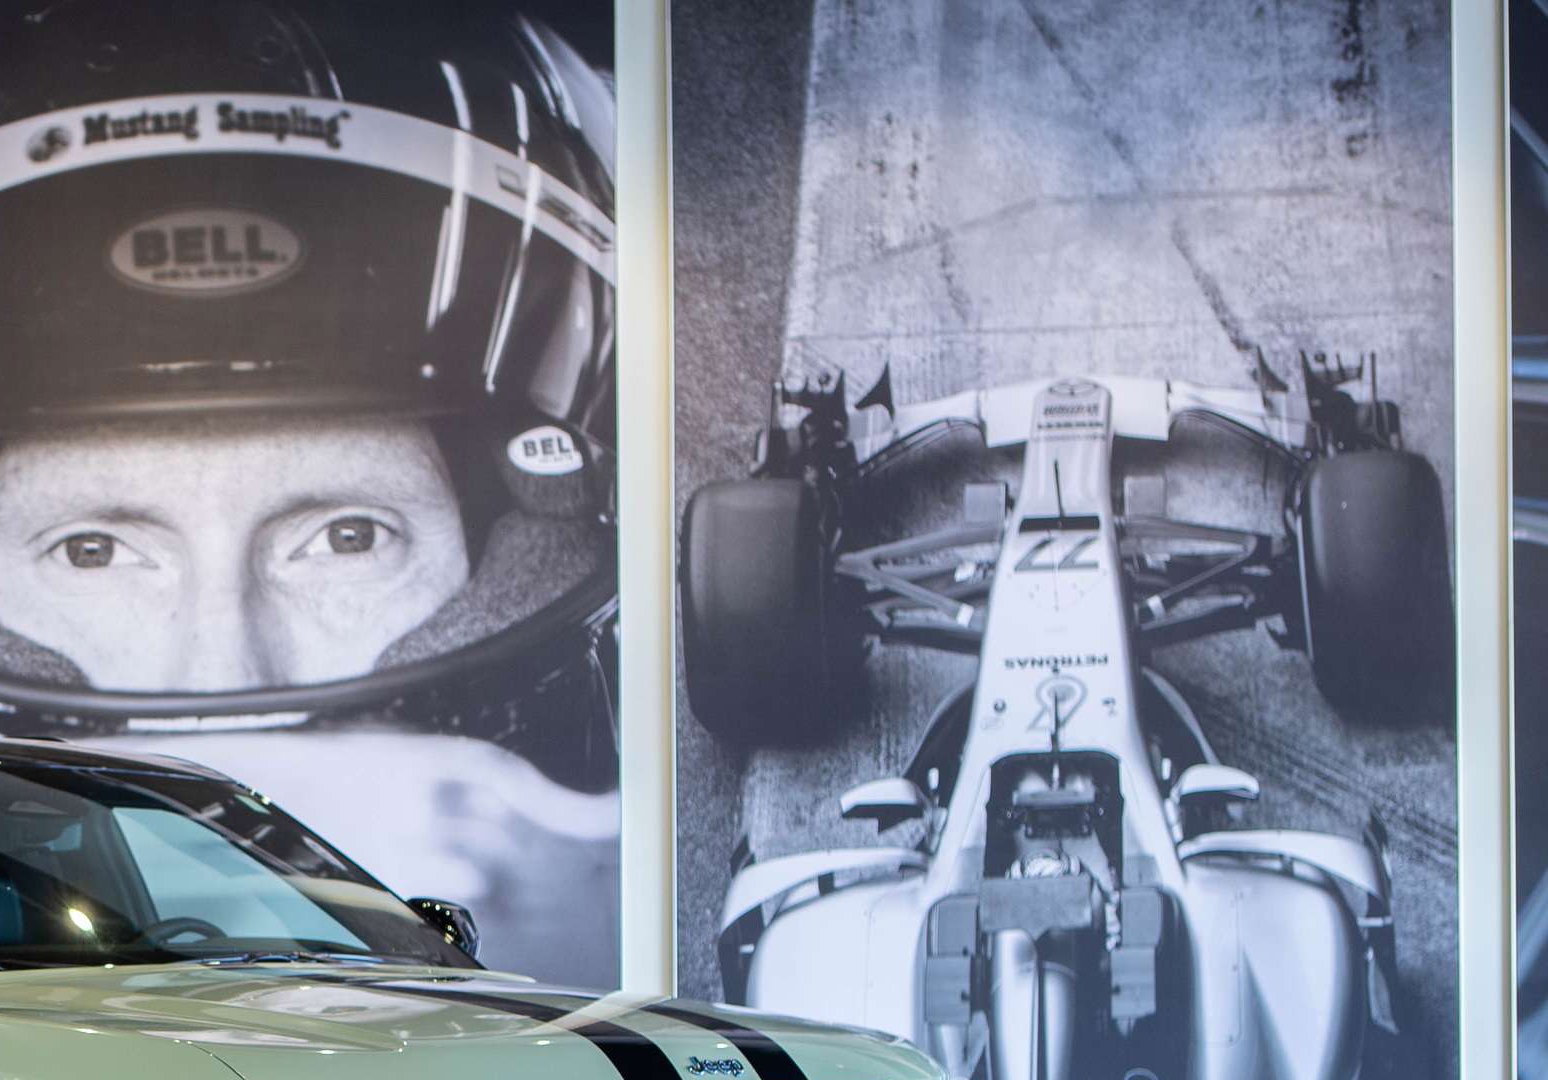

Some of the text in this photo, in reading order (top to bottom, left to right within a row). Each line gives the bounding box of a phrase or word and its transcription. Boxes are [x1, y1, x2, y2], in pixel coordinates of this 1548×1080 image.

[82, 101, 342, 150] Mustang Sampling
[132, 223, 280, 269] BELL
[1004, 654, 1109, 670] PETRONAS
[688, 1056, 744, 1077] Jeep
